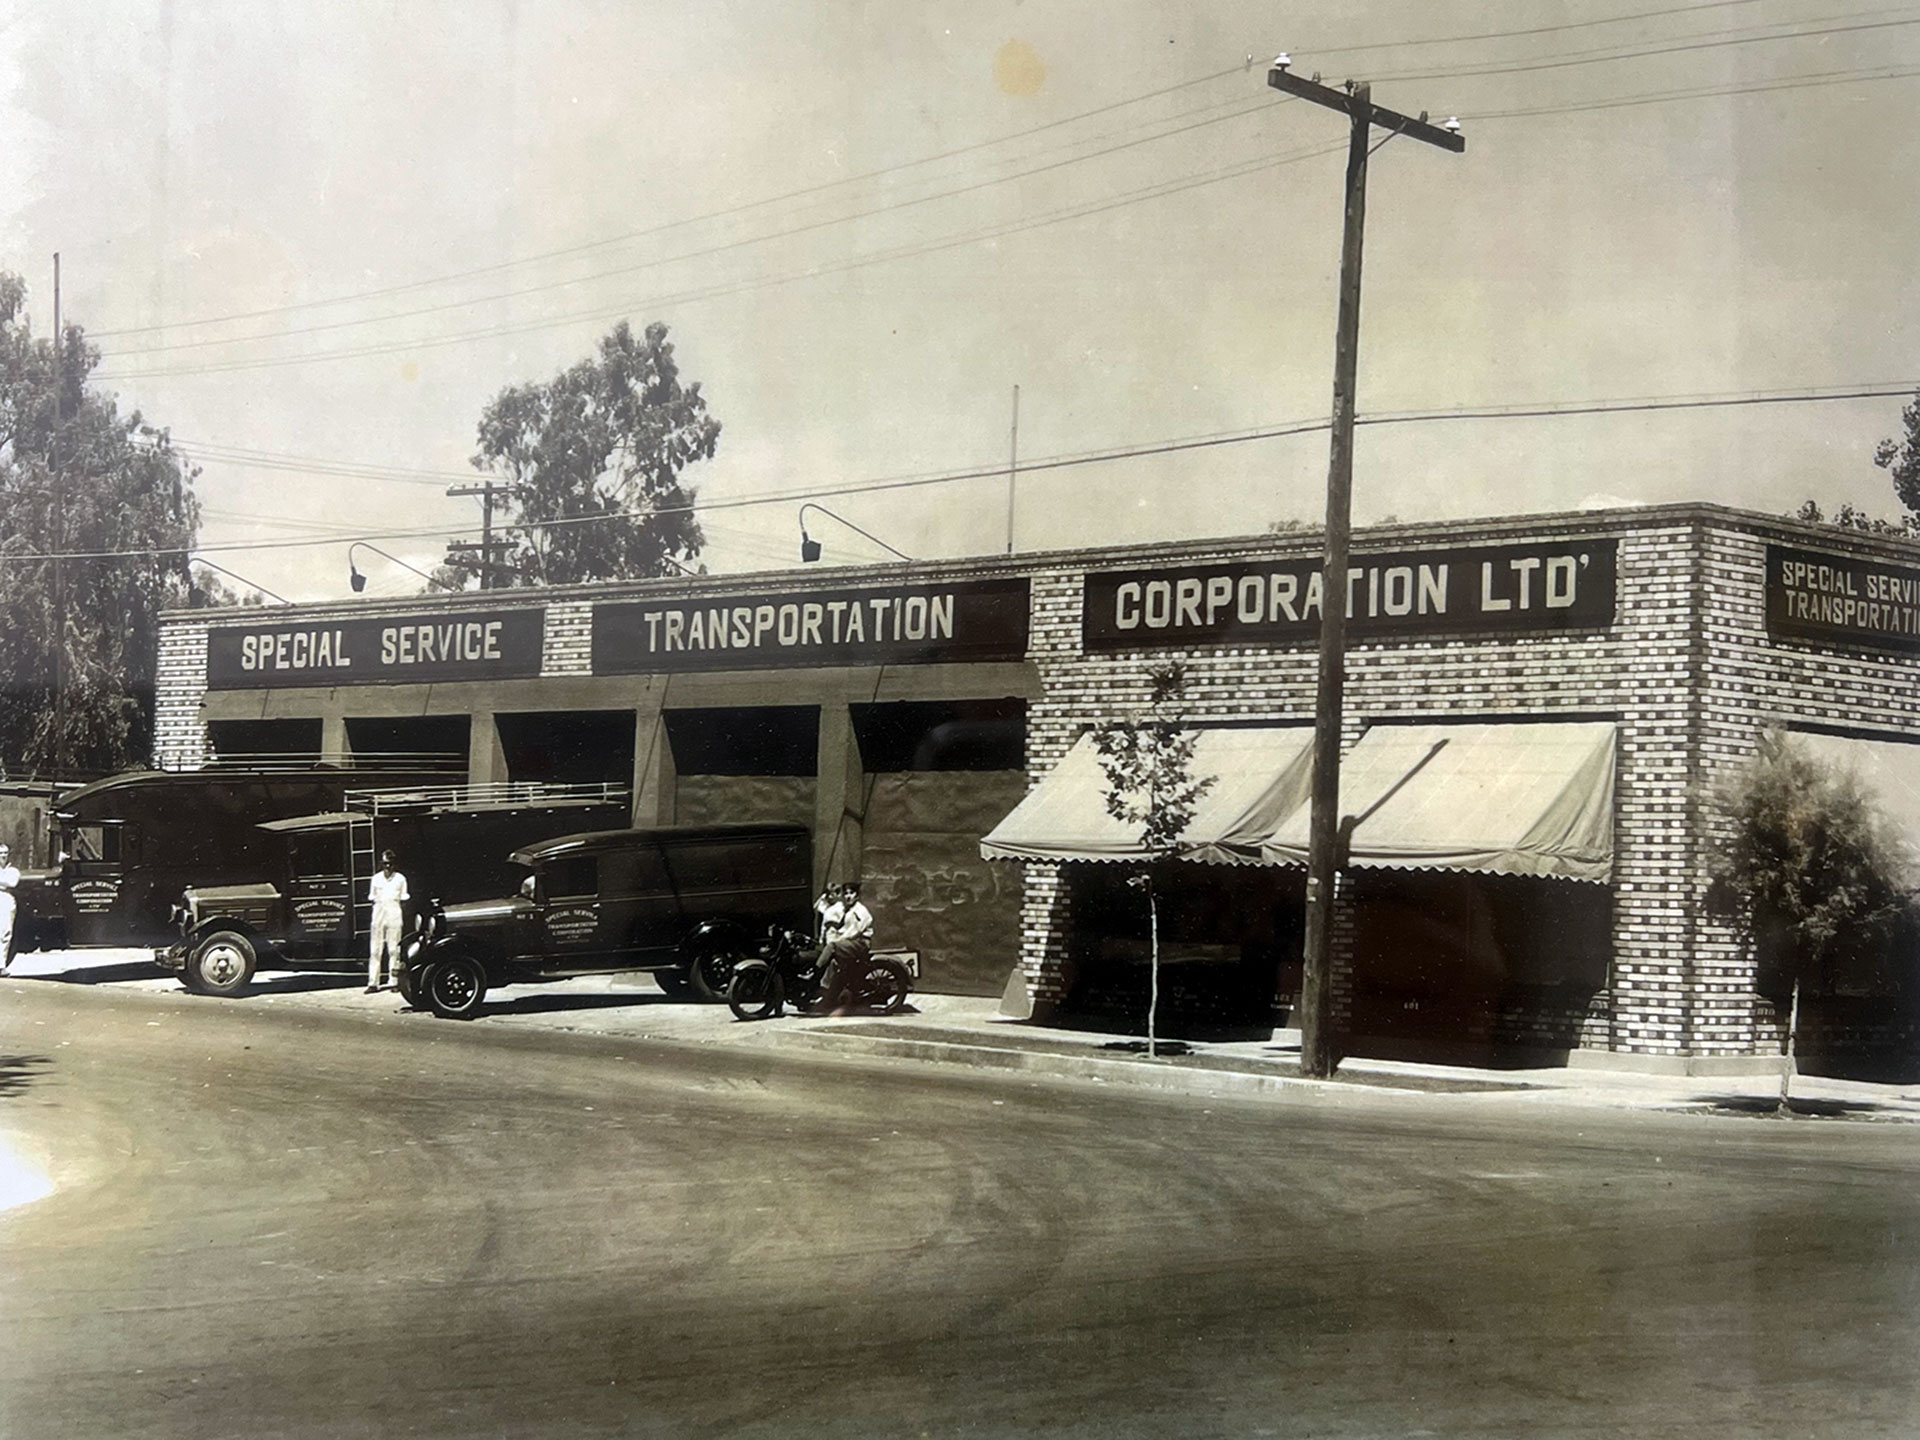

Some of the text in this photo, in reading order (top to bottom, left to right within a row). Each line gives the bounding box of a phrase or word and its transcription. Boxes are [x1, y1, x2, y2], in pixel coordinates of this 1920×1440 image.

[1783, 561, 1920, 605] SPECIAL SERVI
[241, 630, 350, 670] SPECIAL
[381, 622, 502, 665] SERVICE
[644, 594, 954, 653] TRANSPORTATION
[1116, 564, 1448, 630] CORPORATION
[1785, 590, 1920, 635] TRANSPORTATI
